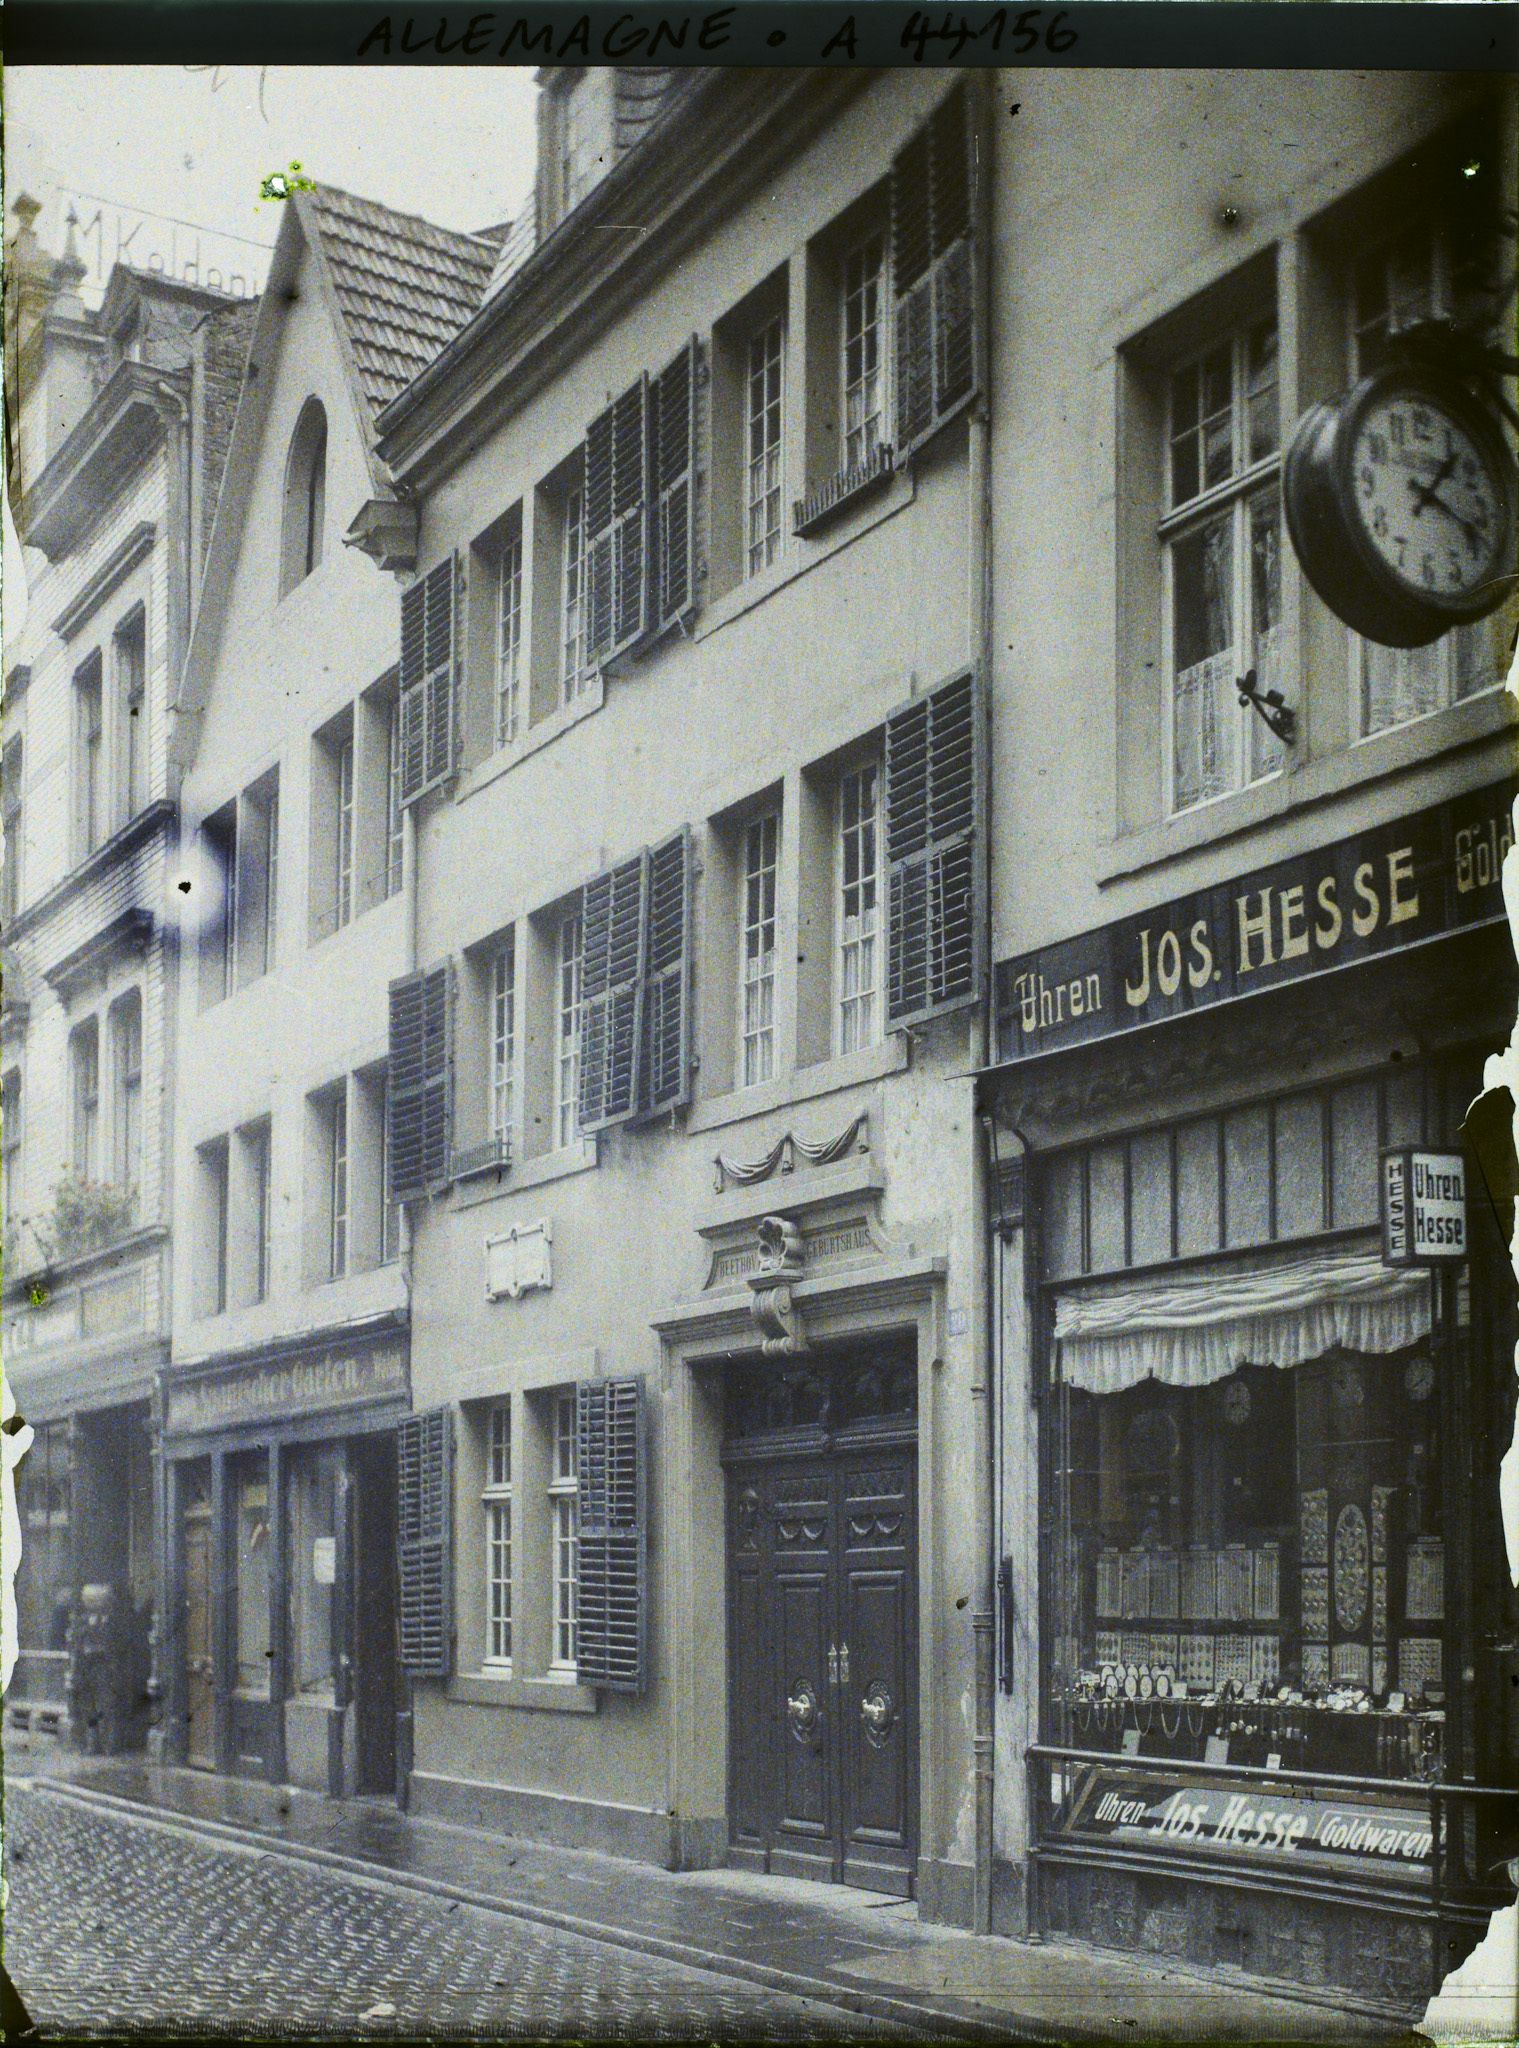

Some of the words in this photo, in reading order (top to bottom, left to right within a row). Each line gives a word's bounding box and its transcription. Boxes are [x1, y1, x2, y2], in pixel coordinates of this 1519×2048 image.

[357, 7, 738, 59] ALLEMAGNE
[821, 14, 863, 59] A
[900, 8, 1080, 62] 44156
[1014, 972, 1102, 1033] Uhren
[1125, 920, 1221, 1007] JOS.
[1236, 847, 1420, 974] HESSE
[1388, 1163, 1404, 1250] HESSE
[1415, 1163, 1463, 1201] Uhren
[1416, 1207, 1463, 1245] Hesse
[1094, 1793, 1146, 1824] Uhren
[1150, 1790, 1208, 1838] Jos.
[1213, 1795, 1309, 1851] Hesse
[1320, 1815, 1434, 1859] Goldwaren
